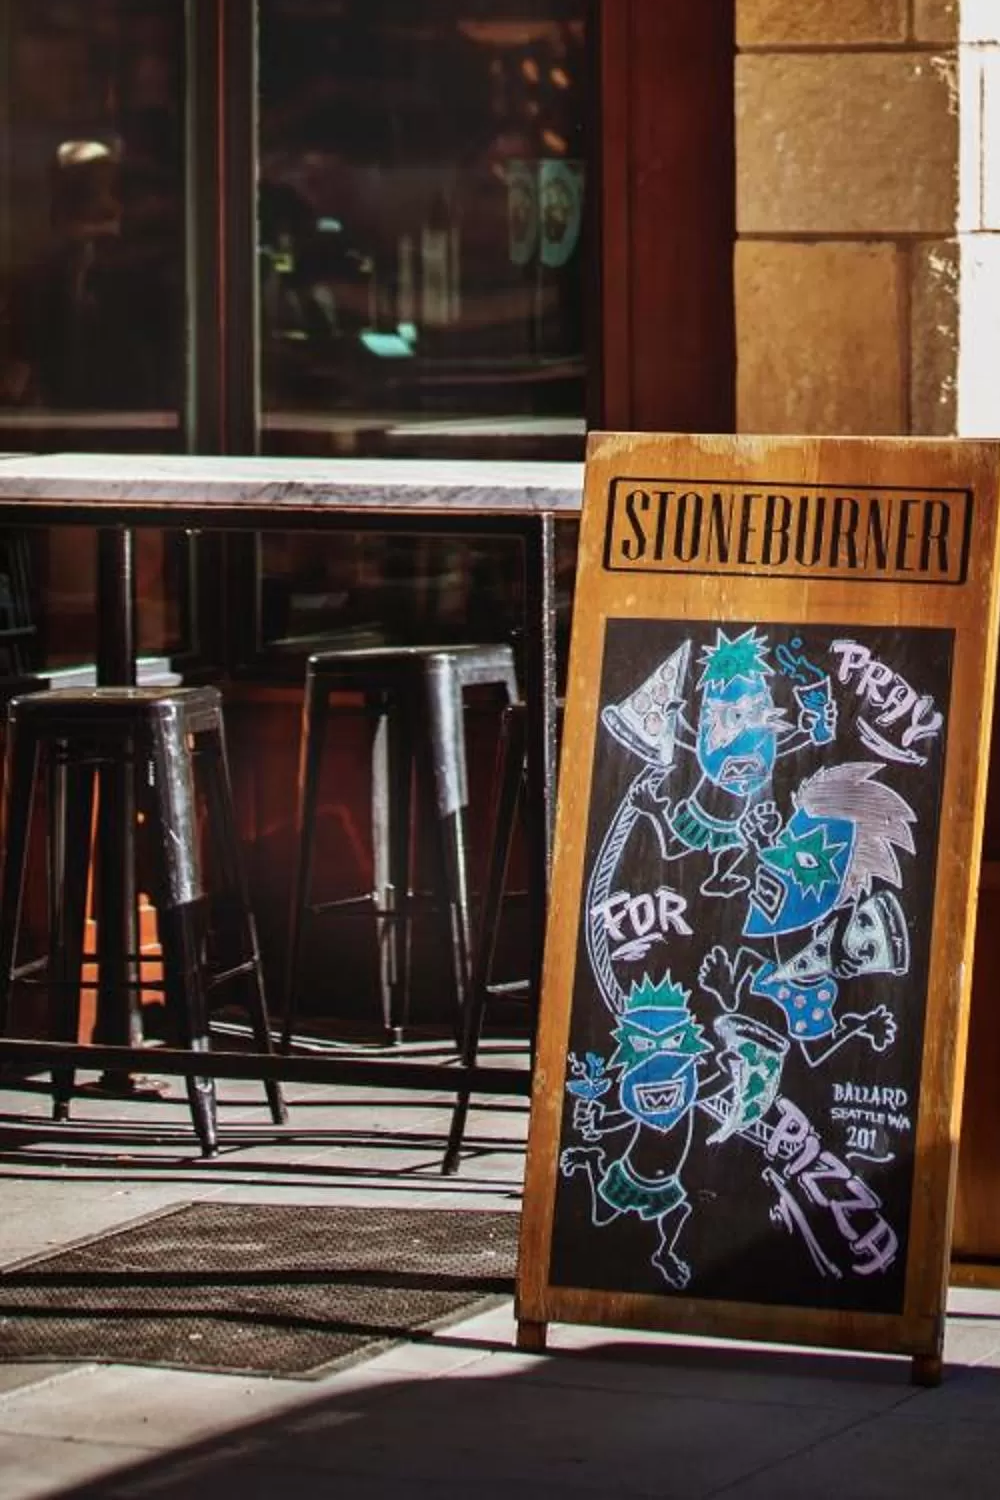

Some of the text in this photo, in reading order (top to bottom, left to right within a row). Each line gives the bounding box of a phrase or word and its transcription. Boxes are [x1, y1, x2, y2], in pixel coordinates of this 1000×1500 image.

[621, 488, 951, 573] STONEBURNER
[829, 639, 944, 747] PRAY
[589, 885, 694, 942] FOR
[830, 1106, 912, 1133] SEATTLE WA
[831, 1081, 909, 1112] BALLARD
[767, 1094, 899, 1277] PIZZA
